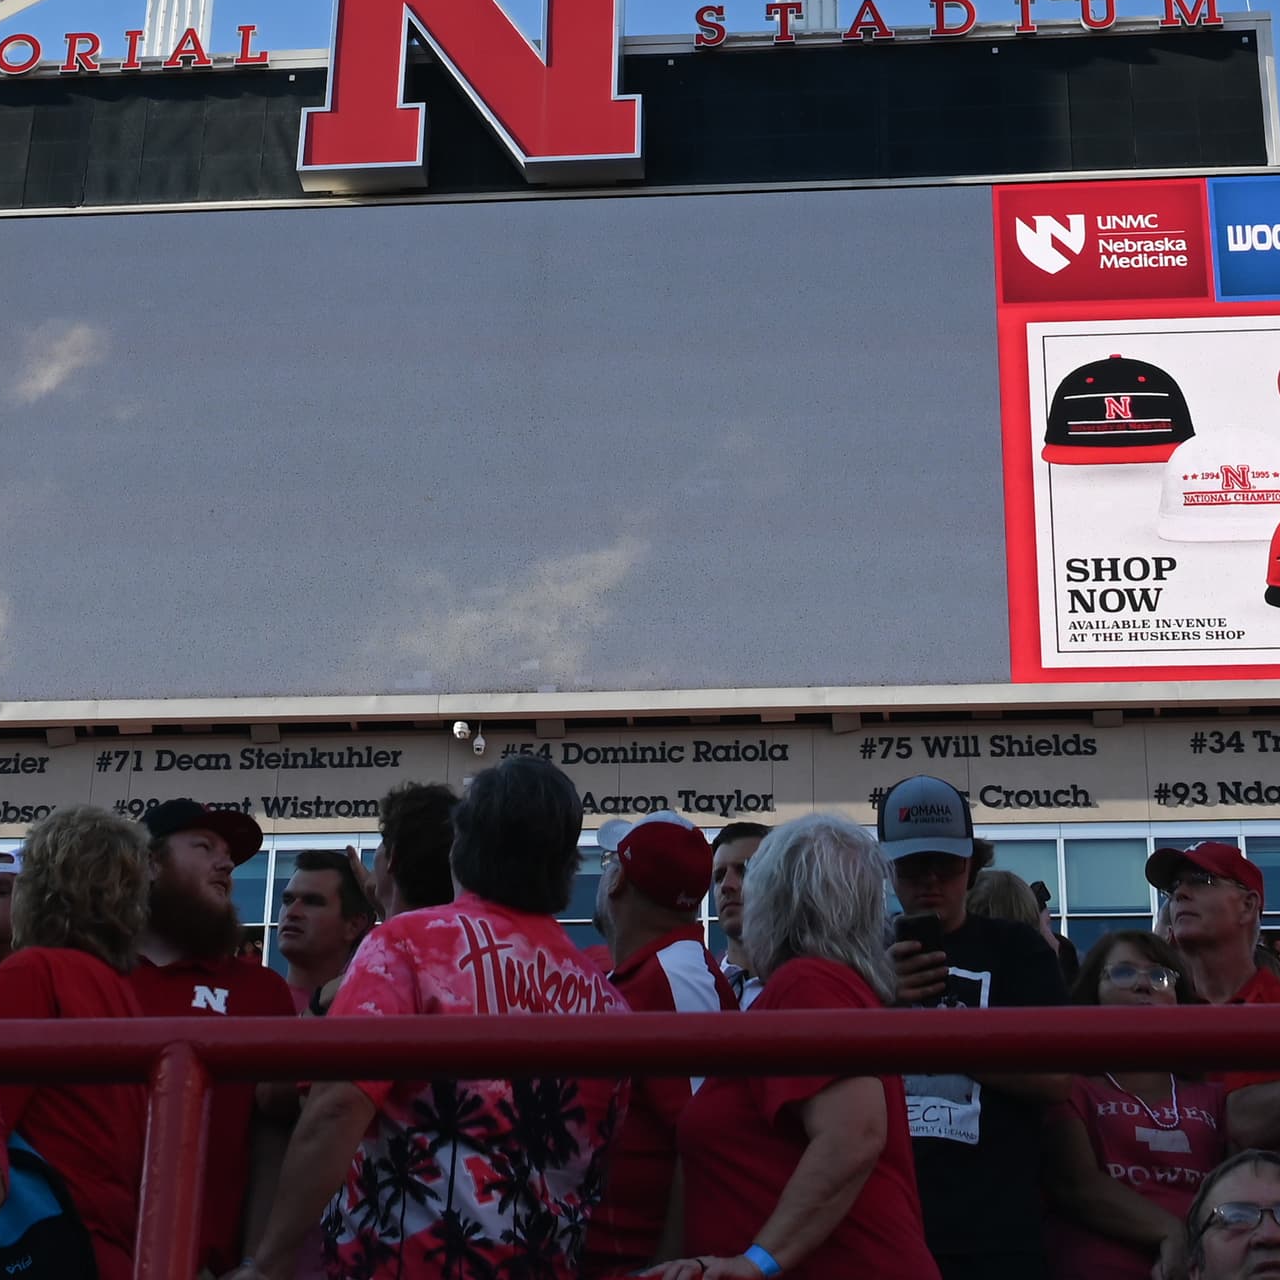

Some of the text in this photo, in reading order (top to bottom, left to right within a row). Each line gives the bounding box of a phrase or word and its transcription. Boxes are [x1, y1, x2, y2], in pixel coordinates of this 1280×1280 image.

[1096, 214, 1159, 231] UNMC
[1098, 237, 1188, 254] Nebraska
[1099, 252, 1188, 269] Medicine
[1104, 396, 1133, 419] N
[1201, 464, 1270, 489] 1994 N 1995
[1184, 493, 1231, 503] NATIONAL
[1066, 557, 1177, 583] SHOP
[1067, 588, 1164, 614] NOW
[1068, 617, 1227, 631] AVAILABLE IN-VENUE
[1068, 629, 1246, 643] AT THE HUSKERS SHOP
[561, 741, 685, 765] Dominic
[692, 740, 790, 763] Raiola
[860, 734, 1097, 760] #75 Will Shields
[1190, 730, 1245, 754] #34
[96, 746, 403, 773] #71 Dean Steinkuhler
[581, 789, 774, 818] Aaron Taylor
[979, 784, 1092, 808] Crouch
[1154, 782, 1208, 805] #93
[261, 795, 381, 818] Wistrom
[910, 803, 952, 817] OMAHA
[191, 984, 230, 1015] N
[906, 1104, 960, 1126] ECT
[1104, 1162, 1208, 1186] POWE
